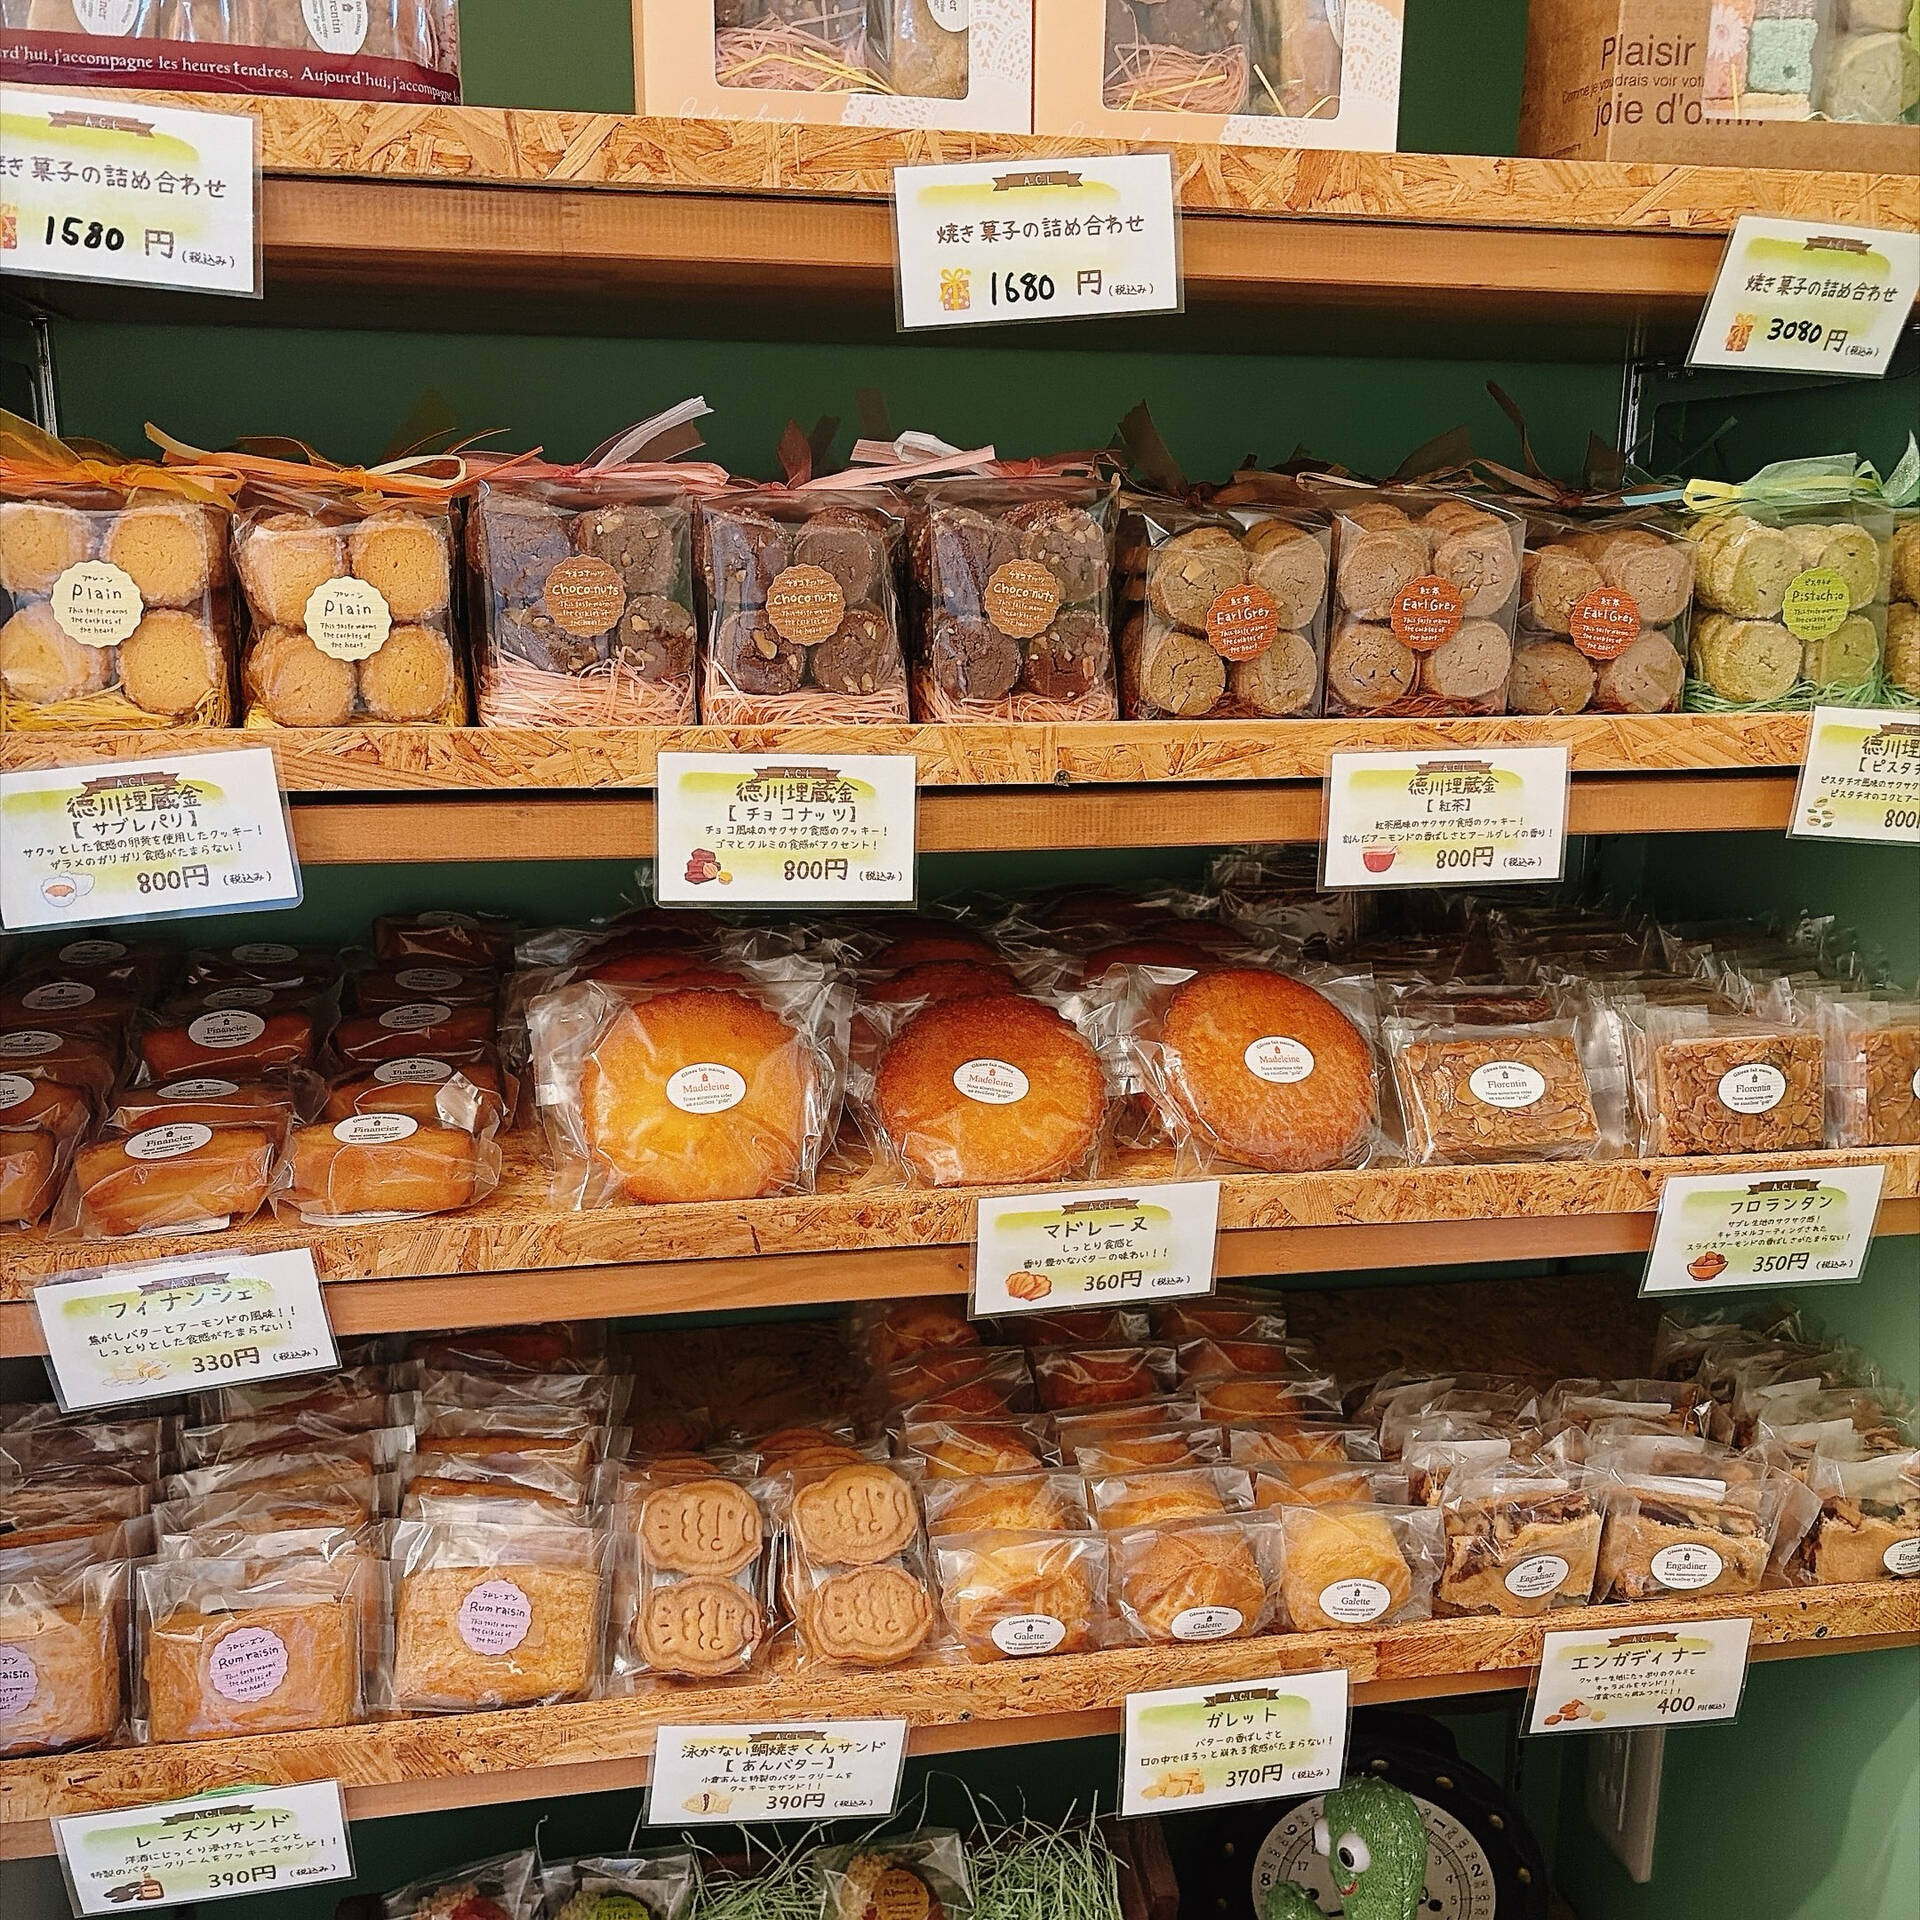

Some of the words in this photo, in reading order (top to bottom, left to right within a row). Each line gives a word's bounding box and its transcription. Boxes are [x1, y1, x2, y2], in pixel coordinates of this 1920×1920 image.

[1601, 35, 1697, 71] Plaisir
[54, 50, 153, 71] j'accompagne
[158, 56, 178, 69] les
[182, 57, 231, 74] heures
[232, 61, 294, 80] tendres.
[301, 67, 391, 90] Aujourd'hui,
[1599, 74, 1648, 93] voudrais
[1652, 75, 1677, 87] voir
[1593, 93, 1644, 136] joie
[45, 215, 125, 251] 1580
[936, 214, 1145, 245] 焼き菓子の詰め合わせ
[991, 271, 1055, 306] 1680
[1745, 272, 1898, 303] 焼き菓子の詰め合わせ
[72, 583, 122, 600] Plain
[1792, 589, 1844, 602] Pistachio
[324, 599, 371, 616] Plain
[1402, 598, 1427, 611] Earl
[1430, 598, 1456, 612] Grey
[1217, 609, 1242, 625] Earl
[1243, 607, 1269, 620] Grey
[1583, 607, 1608, 619] Earl
[1609, 610, 1634, 624] Grey
[736, 780, 859, 805] 徳川埋蔵金
[1408, 776, 1499, 796] 徳川埋蔵金
[66, 784, 203, 819] 徳川埋蔵金
[1884, 809, 1920, 829] 800
[1435, 846, 1494, 869] 800円
[136, 863, 210, 894] 800円
[784, 858, 848, 881] 800円
[205, 1024, 249, 1035] Financier
[1258, 1055, 1301, 1064] Madeleine
[682, 1082, 730, 1094] Madeleine
[968, 1074, 1014, 1088] Madeleine
[1487, 1080, 1528, 1088] Florentin
[1735, 1084, 1771, 1093] Florentin
[353, 1125, 400, 1134] Financier
[145, 1134, 194, 1147] Financier
[1730, 1195, 1833, 1215] フロランタン
[1043, 1216, 1148, 1239] マドレーヌ
[1062, 1238, 1133, 1253] しっとり食感と
[1752, 1252, 1809, 1273] 350円
[1084, 1270, 1142, 1292] 360円
[108, 1287, 254, 1319] フィナンシェ
[192, 1346, 260, 1374] 330円
[1665, 1561, 1707, 1571] Engadiner
[470, 1601, 493, 1613] Rum
[495, 1606, 525, 1617] raisin
[1341, 1597, 1371, 1605] Galette
[1013, 1632, 1044, 1640] Galette
[1192, 1622, 1222, 1630] Galette
[218, 1656, 244, 1670] Rum
[246, 1647, 279, 1660] raisin
[1571, 1647, 1706, 1671] エンガディナー
[1207, 1707, 1277, 1729] ガレット
[1225, 1763, 1283, 1788] 370円
[766, 1793, 825, 1809] 390円
[136, 1813, 290, 1849] レーズンサンド
[208, 1864, 277, 1888] 390円
[1260, 1872, 1271, 1886] 8
[1471, 1863, 1484, 1878] 2
